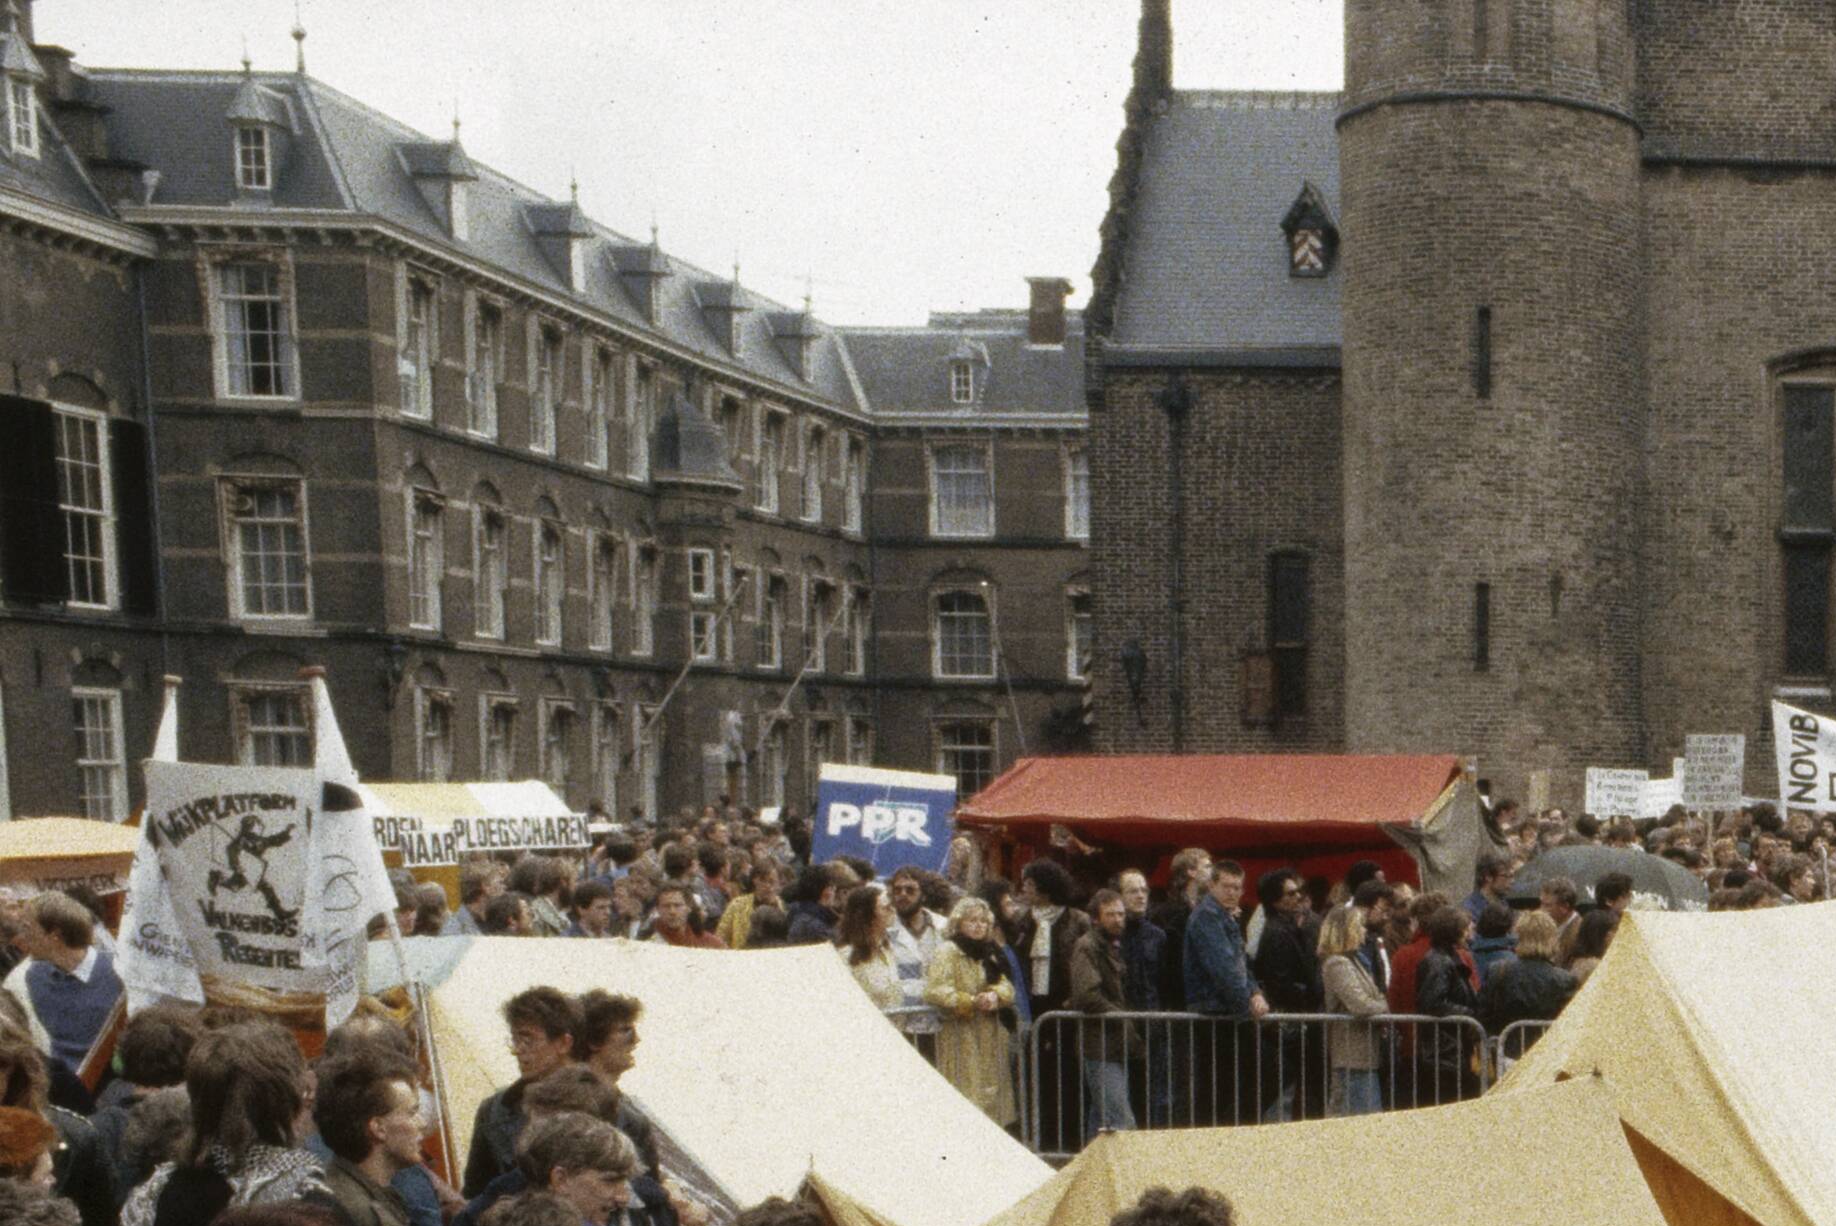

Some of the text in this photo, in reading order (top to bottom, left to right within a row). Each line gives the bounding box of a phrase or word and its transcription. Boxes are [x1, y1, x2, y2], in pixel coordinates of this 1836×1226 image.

[1788, 713, 1819, 803] NOVIB
[400, 831, 458, 864] NAAR
[453, 808, 592, 848] PLOEGSCHAREN
[827, 802, 931, 846] PPR
[215, 931, 304, 971] REGENTE
